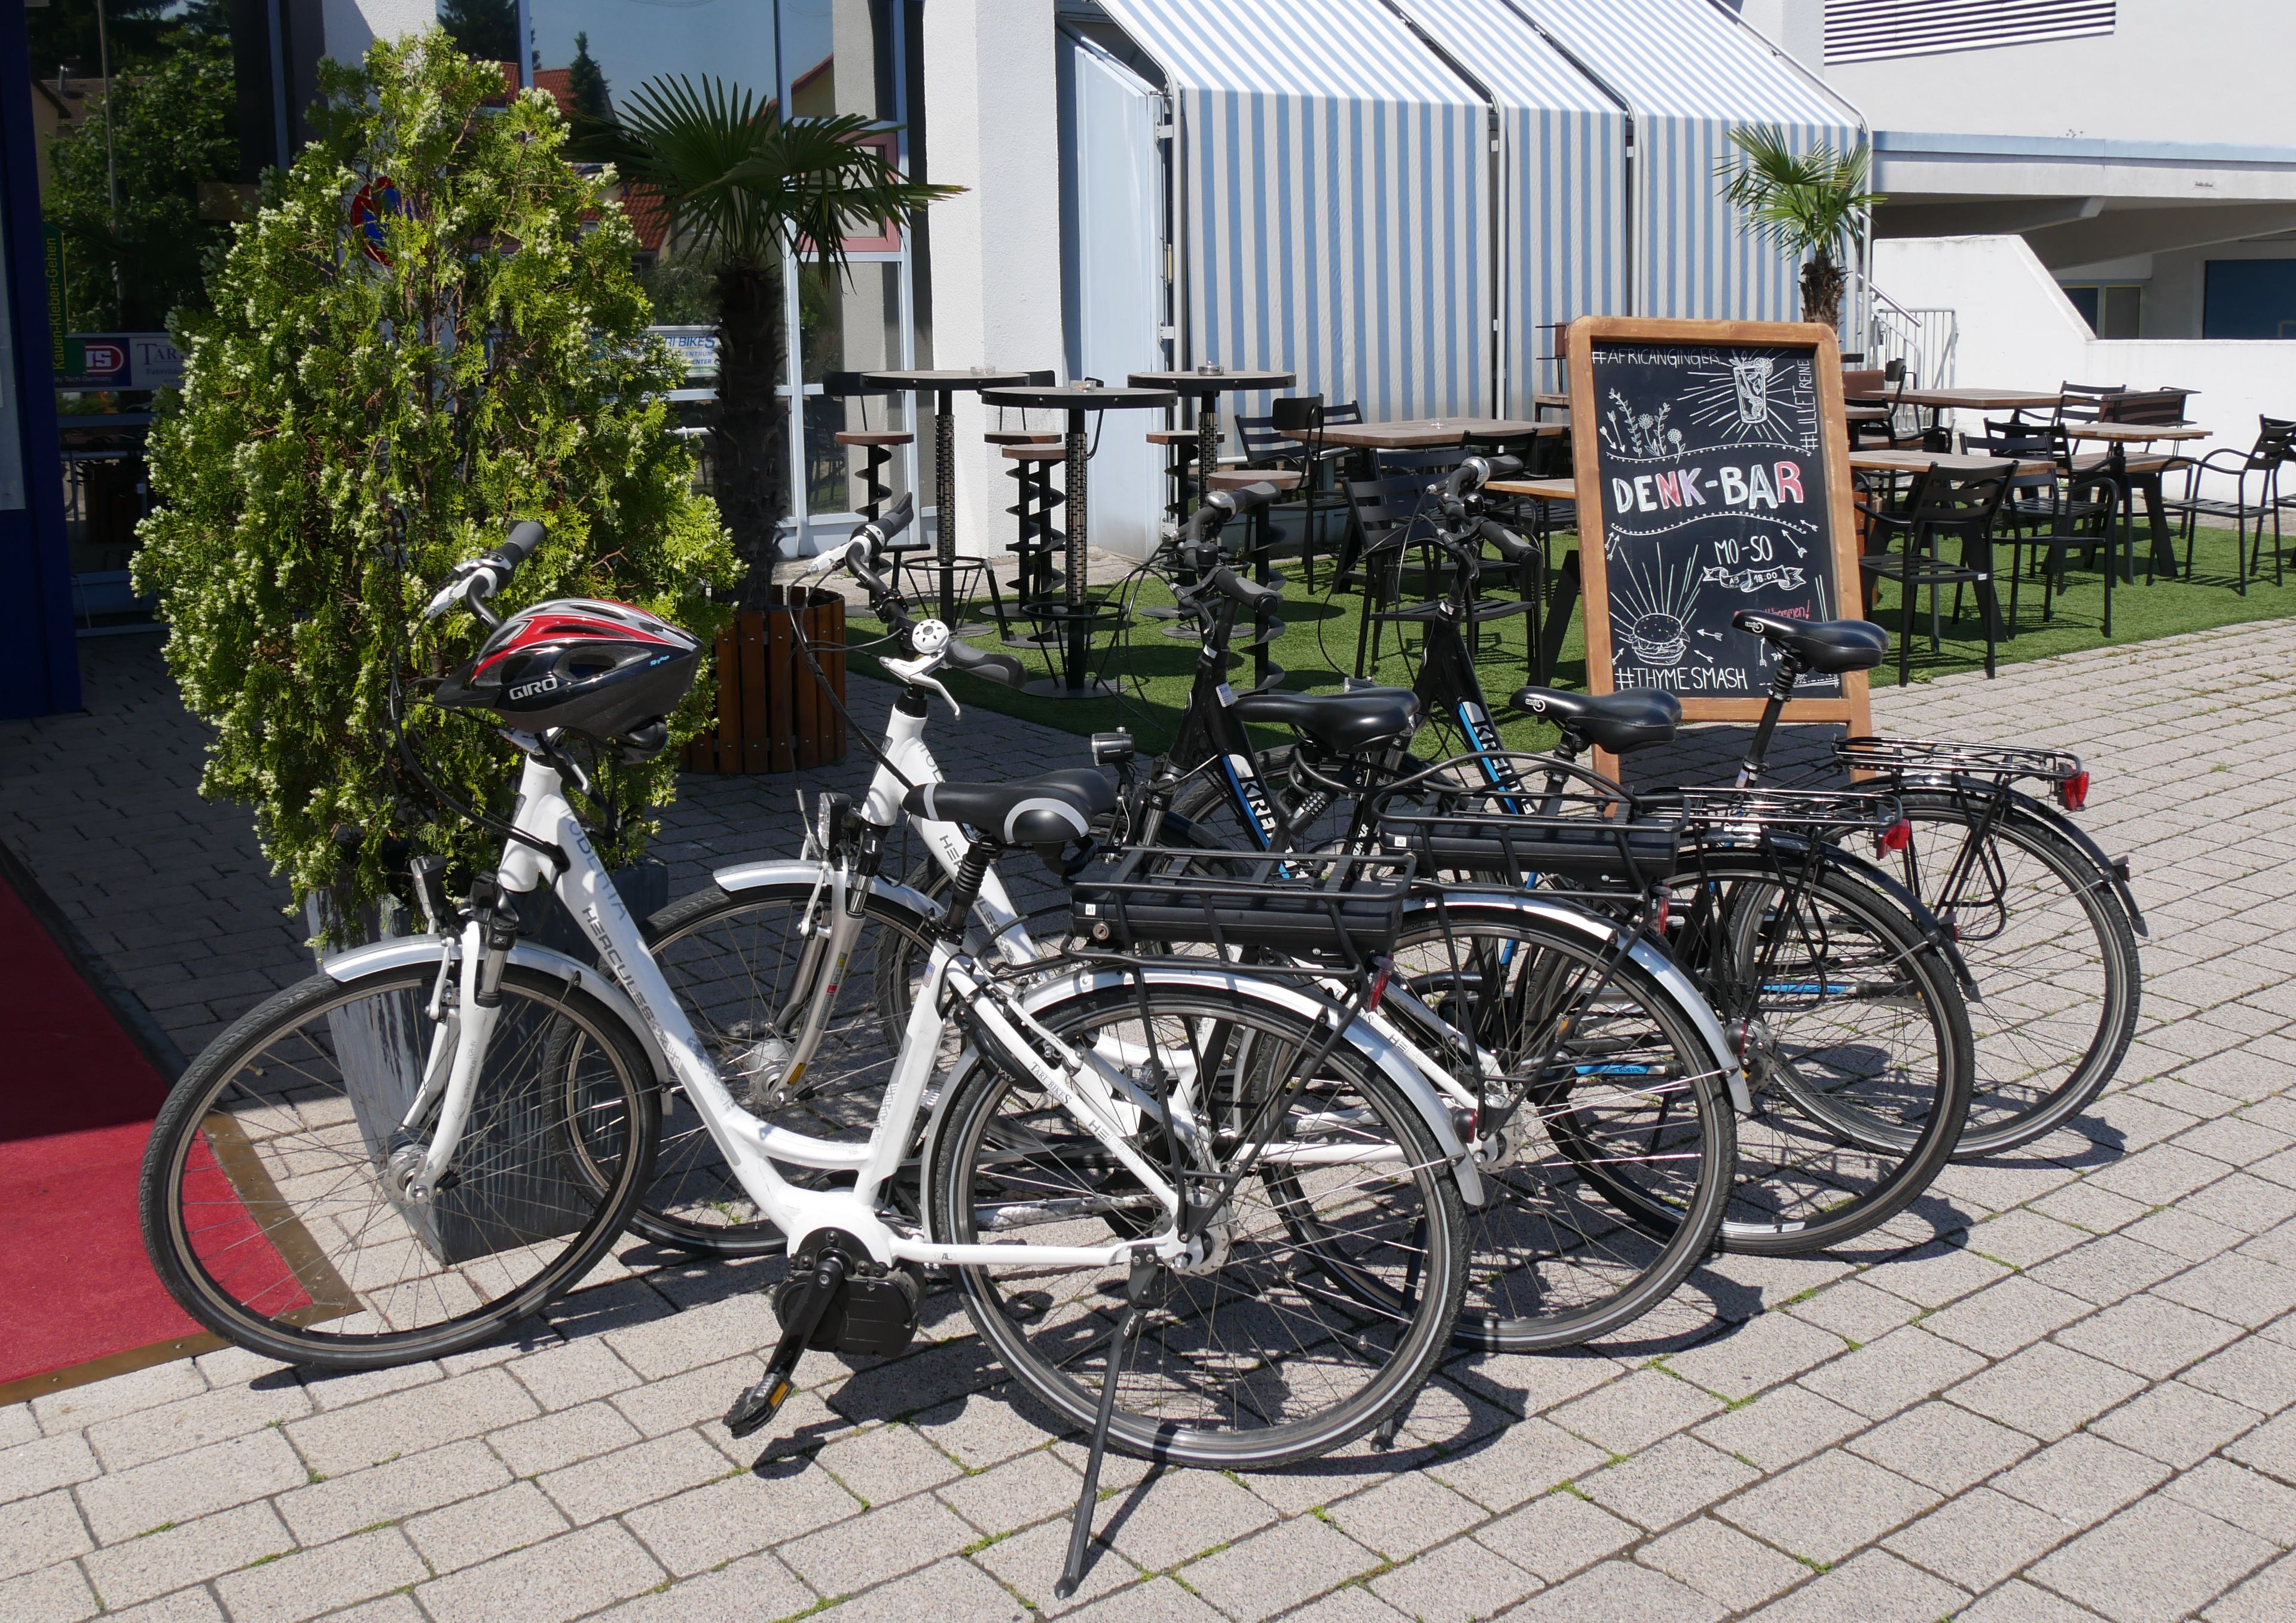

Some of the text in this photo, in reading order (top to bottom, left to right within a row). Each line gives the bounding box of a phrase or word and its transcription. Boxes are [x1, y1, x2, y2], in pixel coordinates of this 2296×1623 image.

[45, 237, 65, 370] Kauen-Kleben-Gehen
[679, 333, 714, 349] BIKES
[1591, 348, 1721, 369] #AFRICANGINGER
[82, 375, 113, 385] Germany
[1612, 461, 1805, 514] DENK-BAR
[1714, 535, 1773, 565] MO-SO
[1729, 571, 1778, 585] AB 18:00
[509, 677, 558, 701] GIRO
[582, 905, 654, 1025] HERCULES
[996, 1066, 1016, 1084] AXA
[1046, 1079, 1073, 1105] BIKES
[1087, 1119, 1111, 1141] HE
